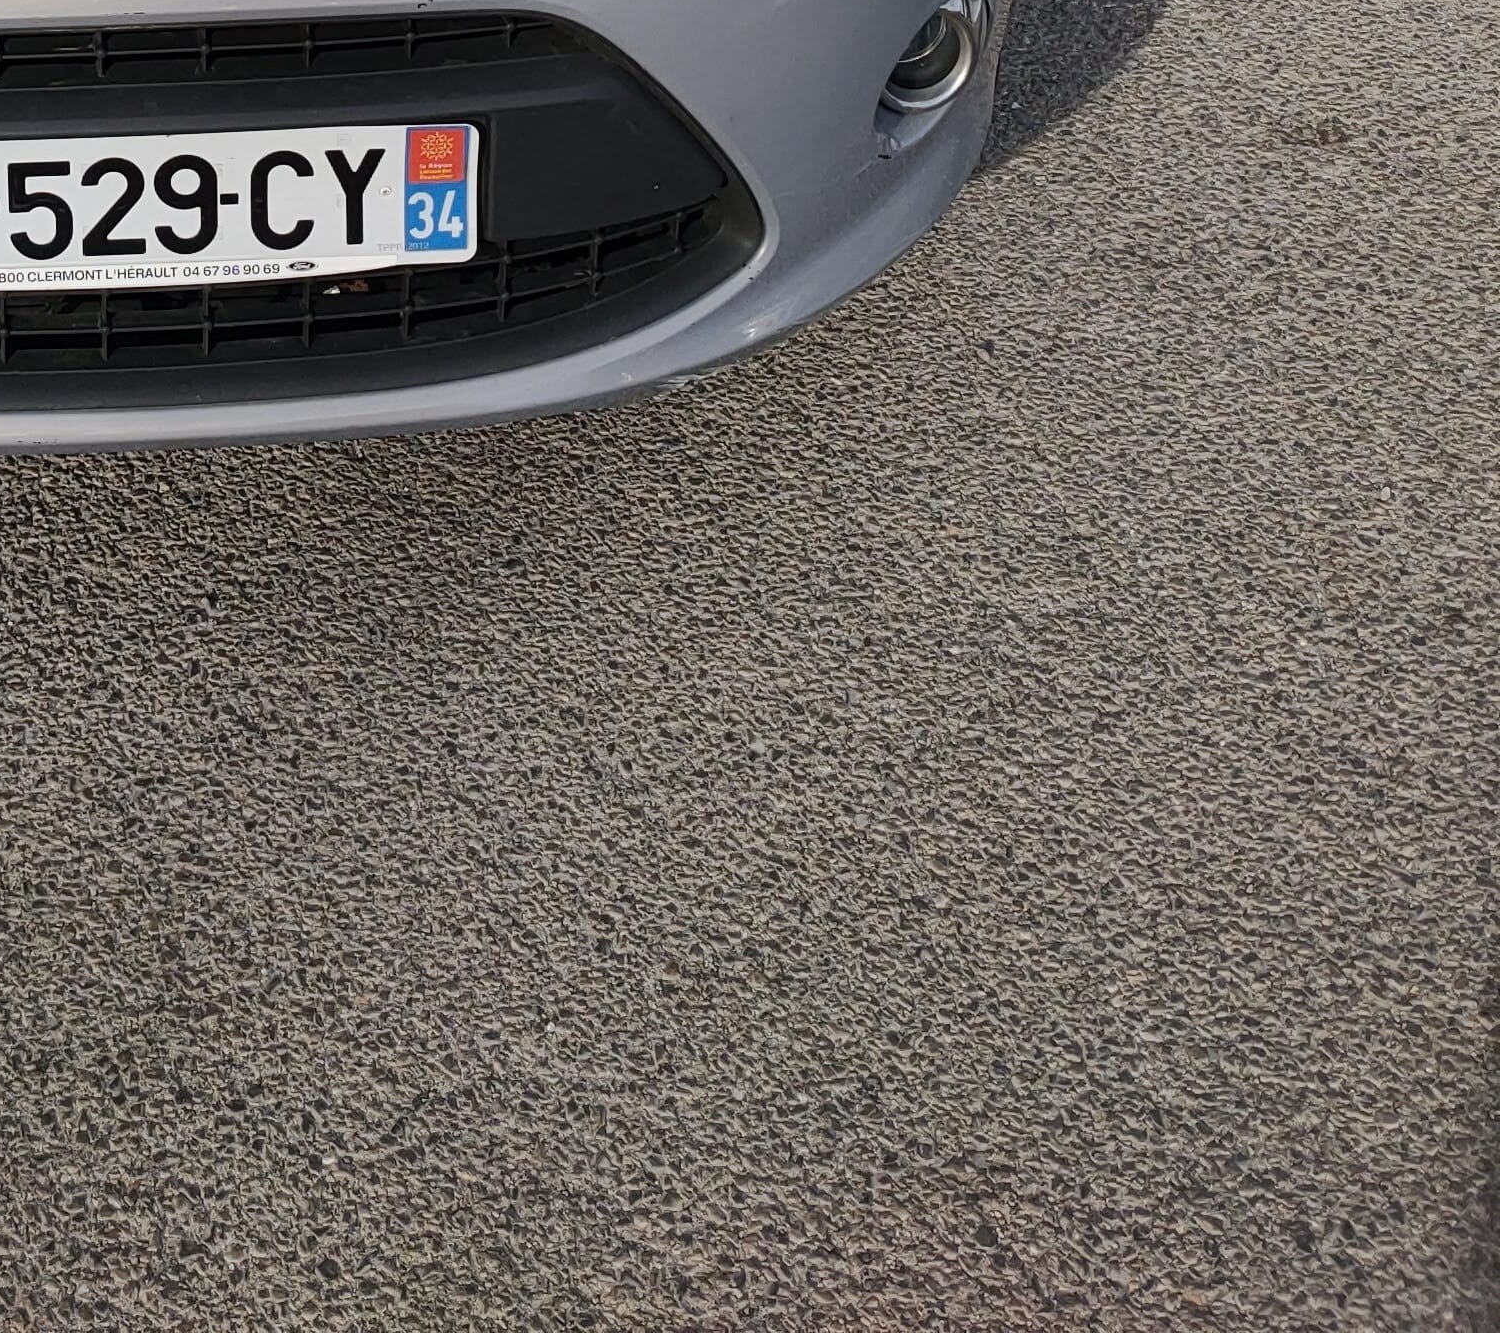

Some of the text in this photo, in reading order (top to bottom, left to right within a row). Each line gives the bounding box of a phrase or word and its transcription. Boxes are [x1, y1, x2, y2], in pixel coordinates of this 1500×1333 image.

[408, 189, 464, 240] 34
[27, 269, 102, 282] CLERMONT
[105, 264, 178, 280] L'HÉRAULT
[182, 265, 200, 278] 04
[203, 264, 221, 277] 67
[222, 264, 241, 277] 96
[243, 263, 261, 276] 90
[263, 263, 280, 275] 69
